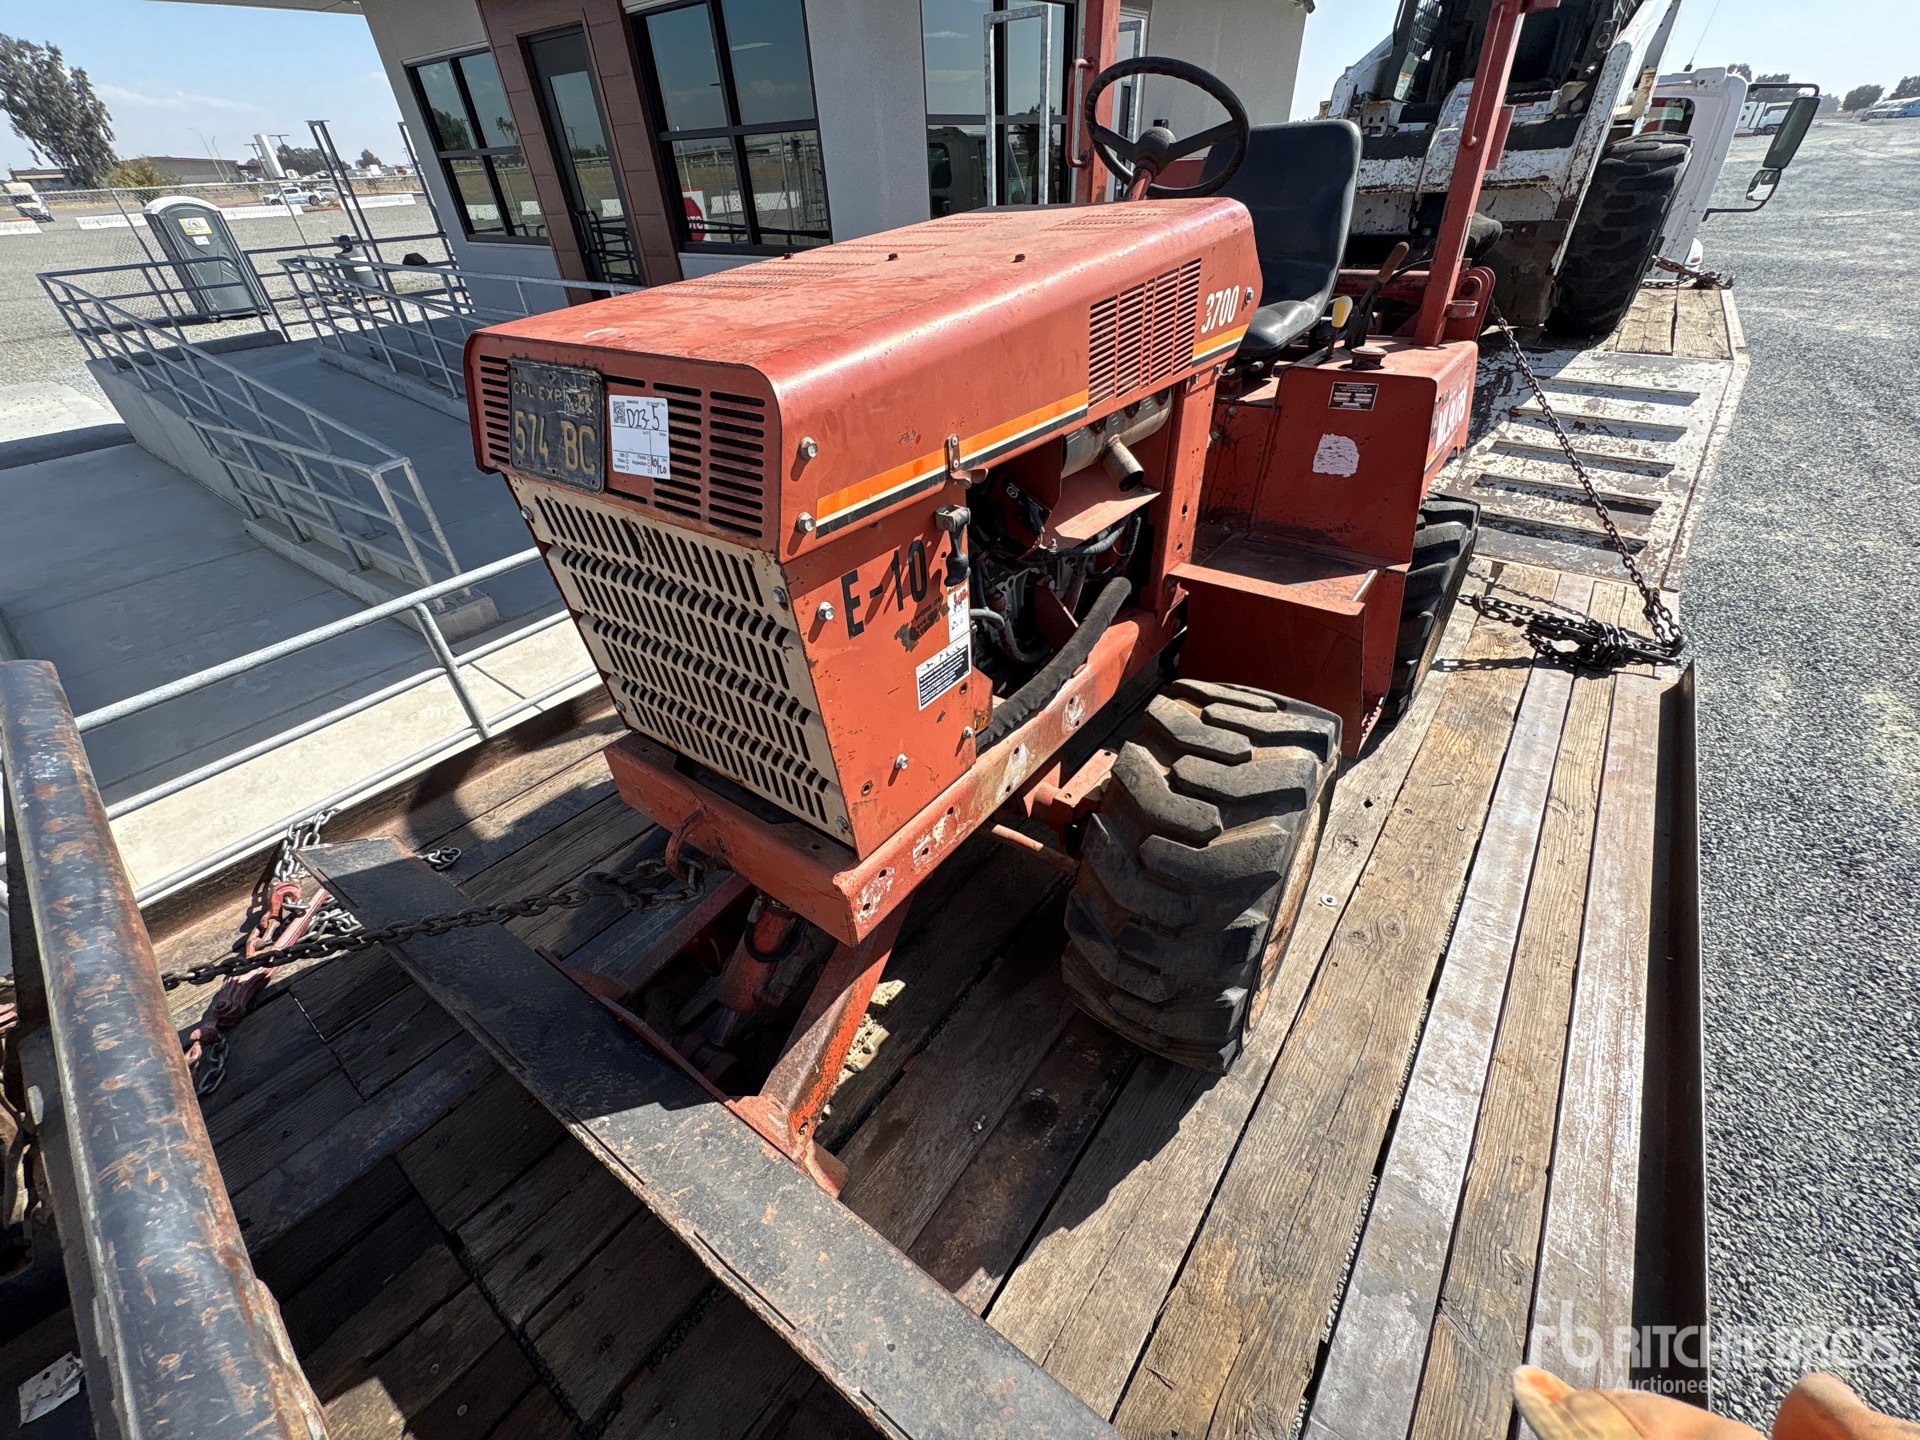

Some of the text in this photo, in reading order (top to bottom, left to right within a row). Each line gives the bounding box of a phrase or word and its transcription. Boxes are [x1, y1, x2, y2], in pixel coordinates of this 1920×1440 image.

[1201, 285, 1240, 334] 3700
[513, 381, 535, 398] CAL
[538, 386, 563, 402] EXP
[514, 410, 597, 476] 574 BC
[840, 539, 928, 640] E-10
